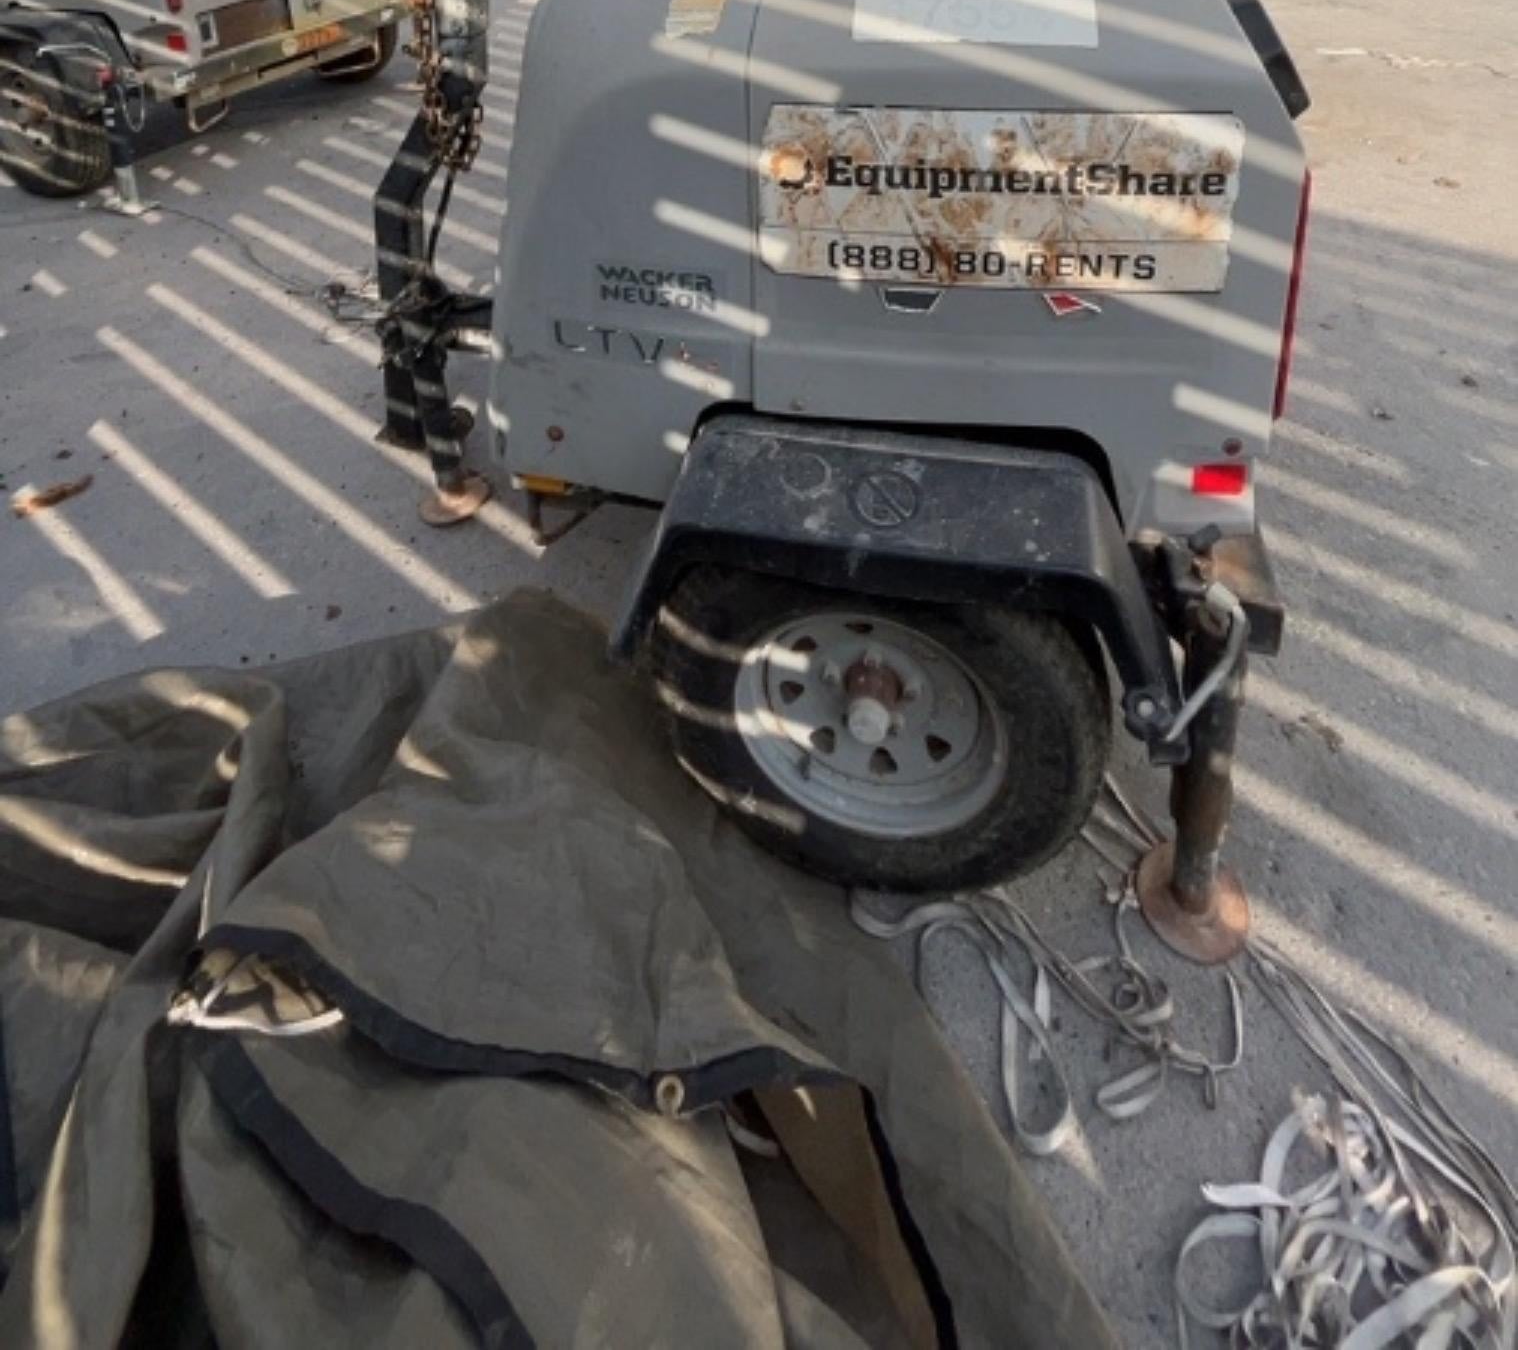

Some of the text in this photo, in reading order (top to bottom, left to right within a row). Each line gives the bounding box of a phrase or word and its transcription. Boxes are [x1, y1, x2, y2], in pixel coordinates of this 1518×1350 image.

[826, 156, 1226, 197] EquipmentShare
[828, 240, 934, 274] (888)
[597, 264, 714, 292] WACKER
[601, 284, 716, 312] NEUSON
